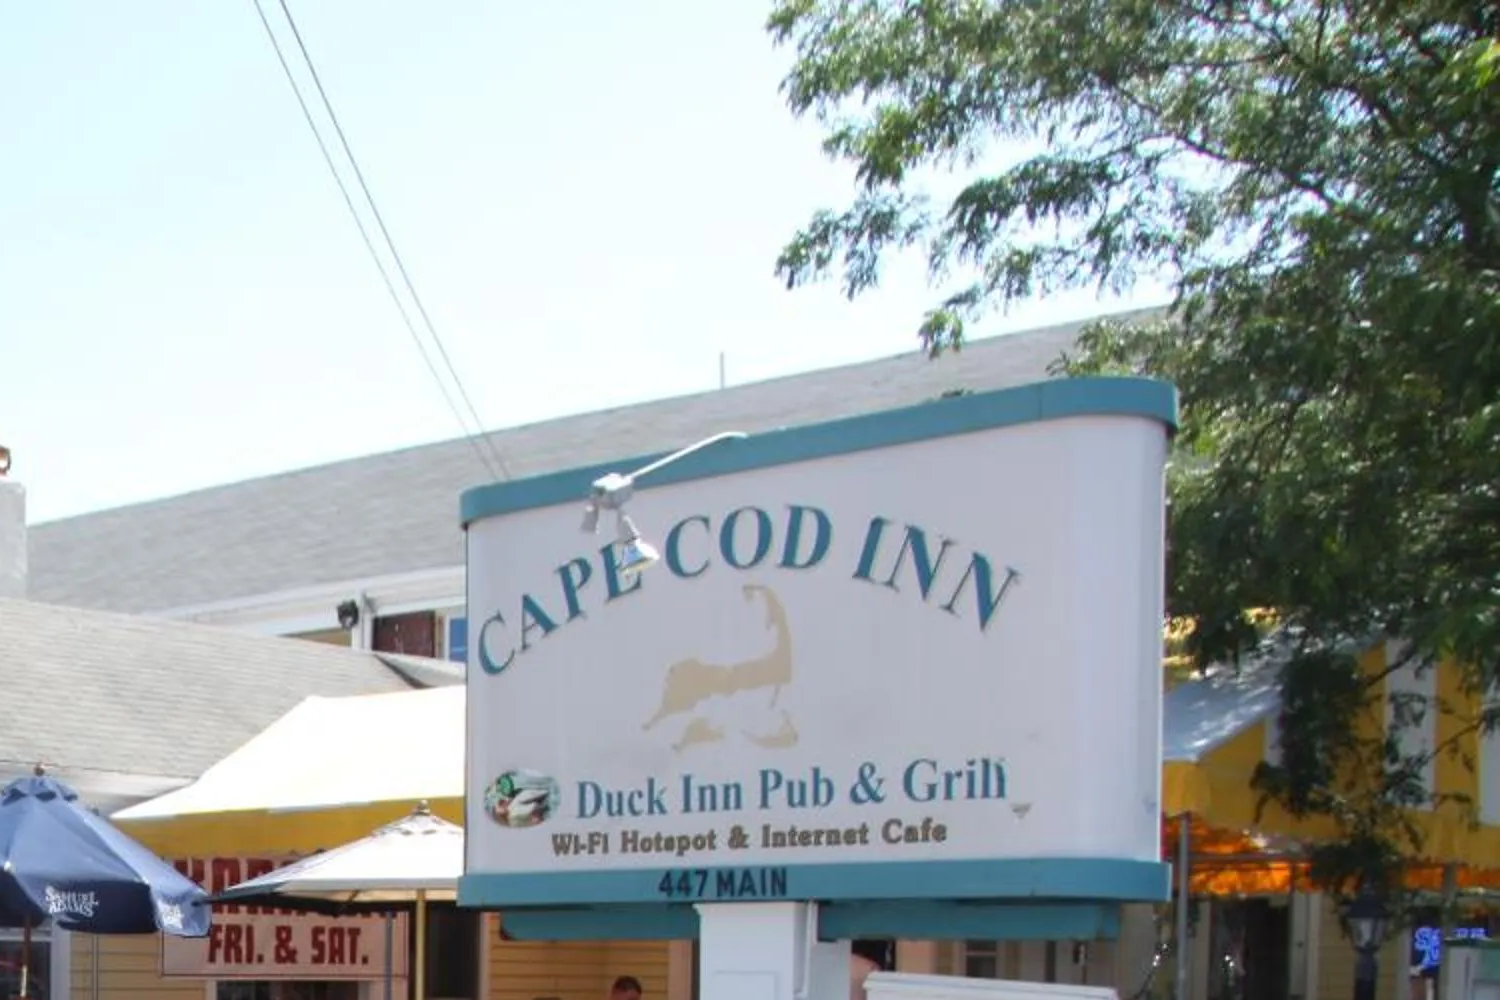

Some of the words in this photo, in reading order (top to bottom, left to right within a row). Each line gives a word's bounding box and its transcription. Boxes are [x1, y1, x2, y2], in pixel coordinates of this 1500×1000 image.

[477, 539, 643, 677] CAPE
[665, 505, 832, 579] COD
[852, 515, 1022, 633] INN
[576, 777, 668, 819] Duck
[681, 773, 743, 814] Inn
[758, 767, 835, 810] Pub
[849, 761, 886, 804] &
[902, 756, 1007, 802] Grill
[727, 825, 749, 849] &
[761, 822, 869, 848] Internet
[881, 817, 947, 844] Cafe
[658, 869, 708, 898] 447
[716, 867, 788, 898] MAIN
[208, 924, 264, 964] FRI.
[274, 926, 298, 965] &
[311, 926, 369, 965] SAT.
